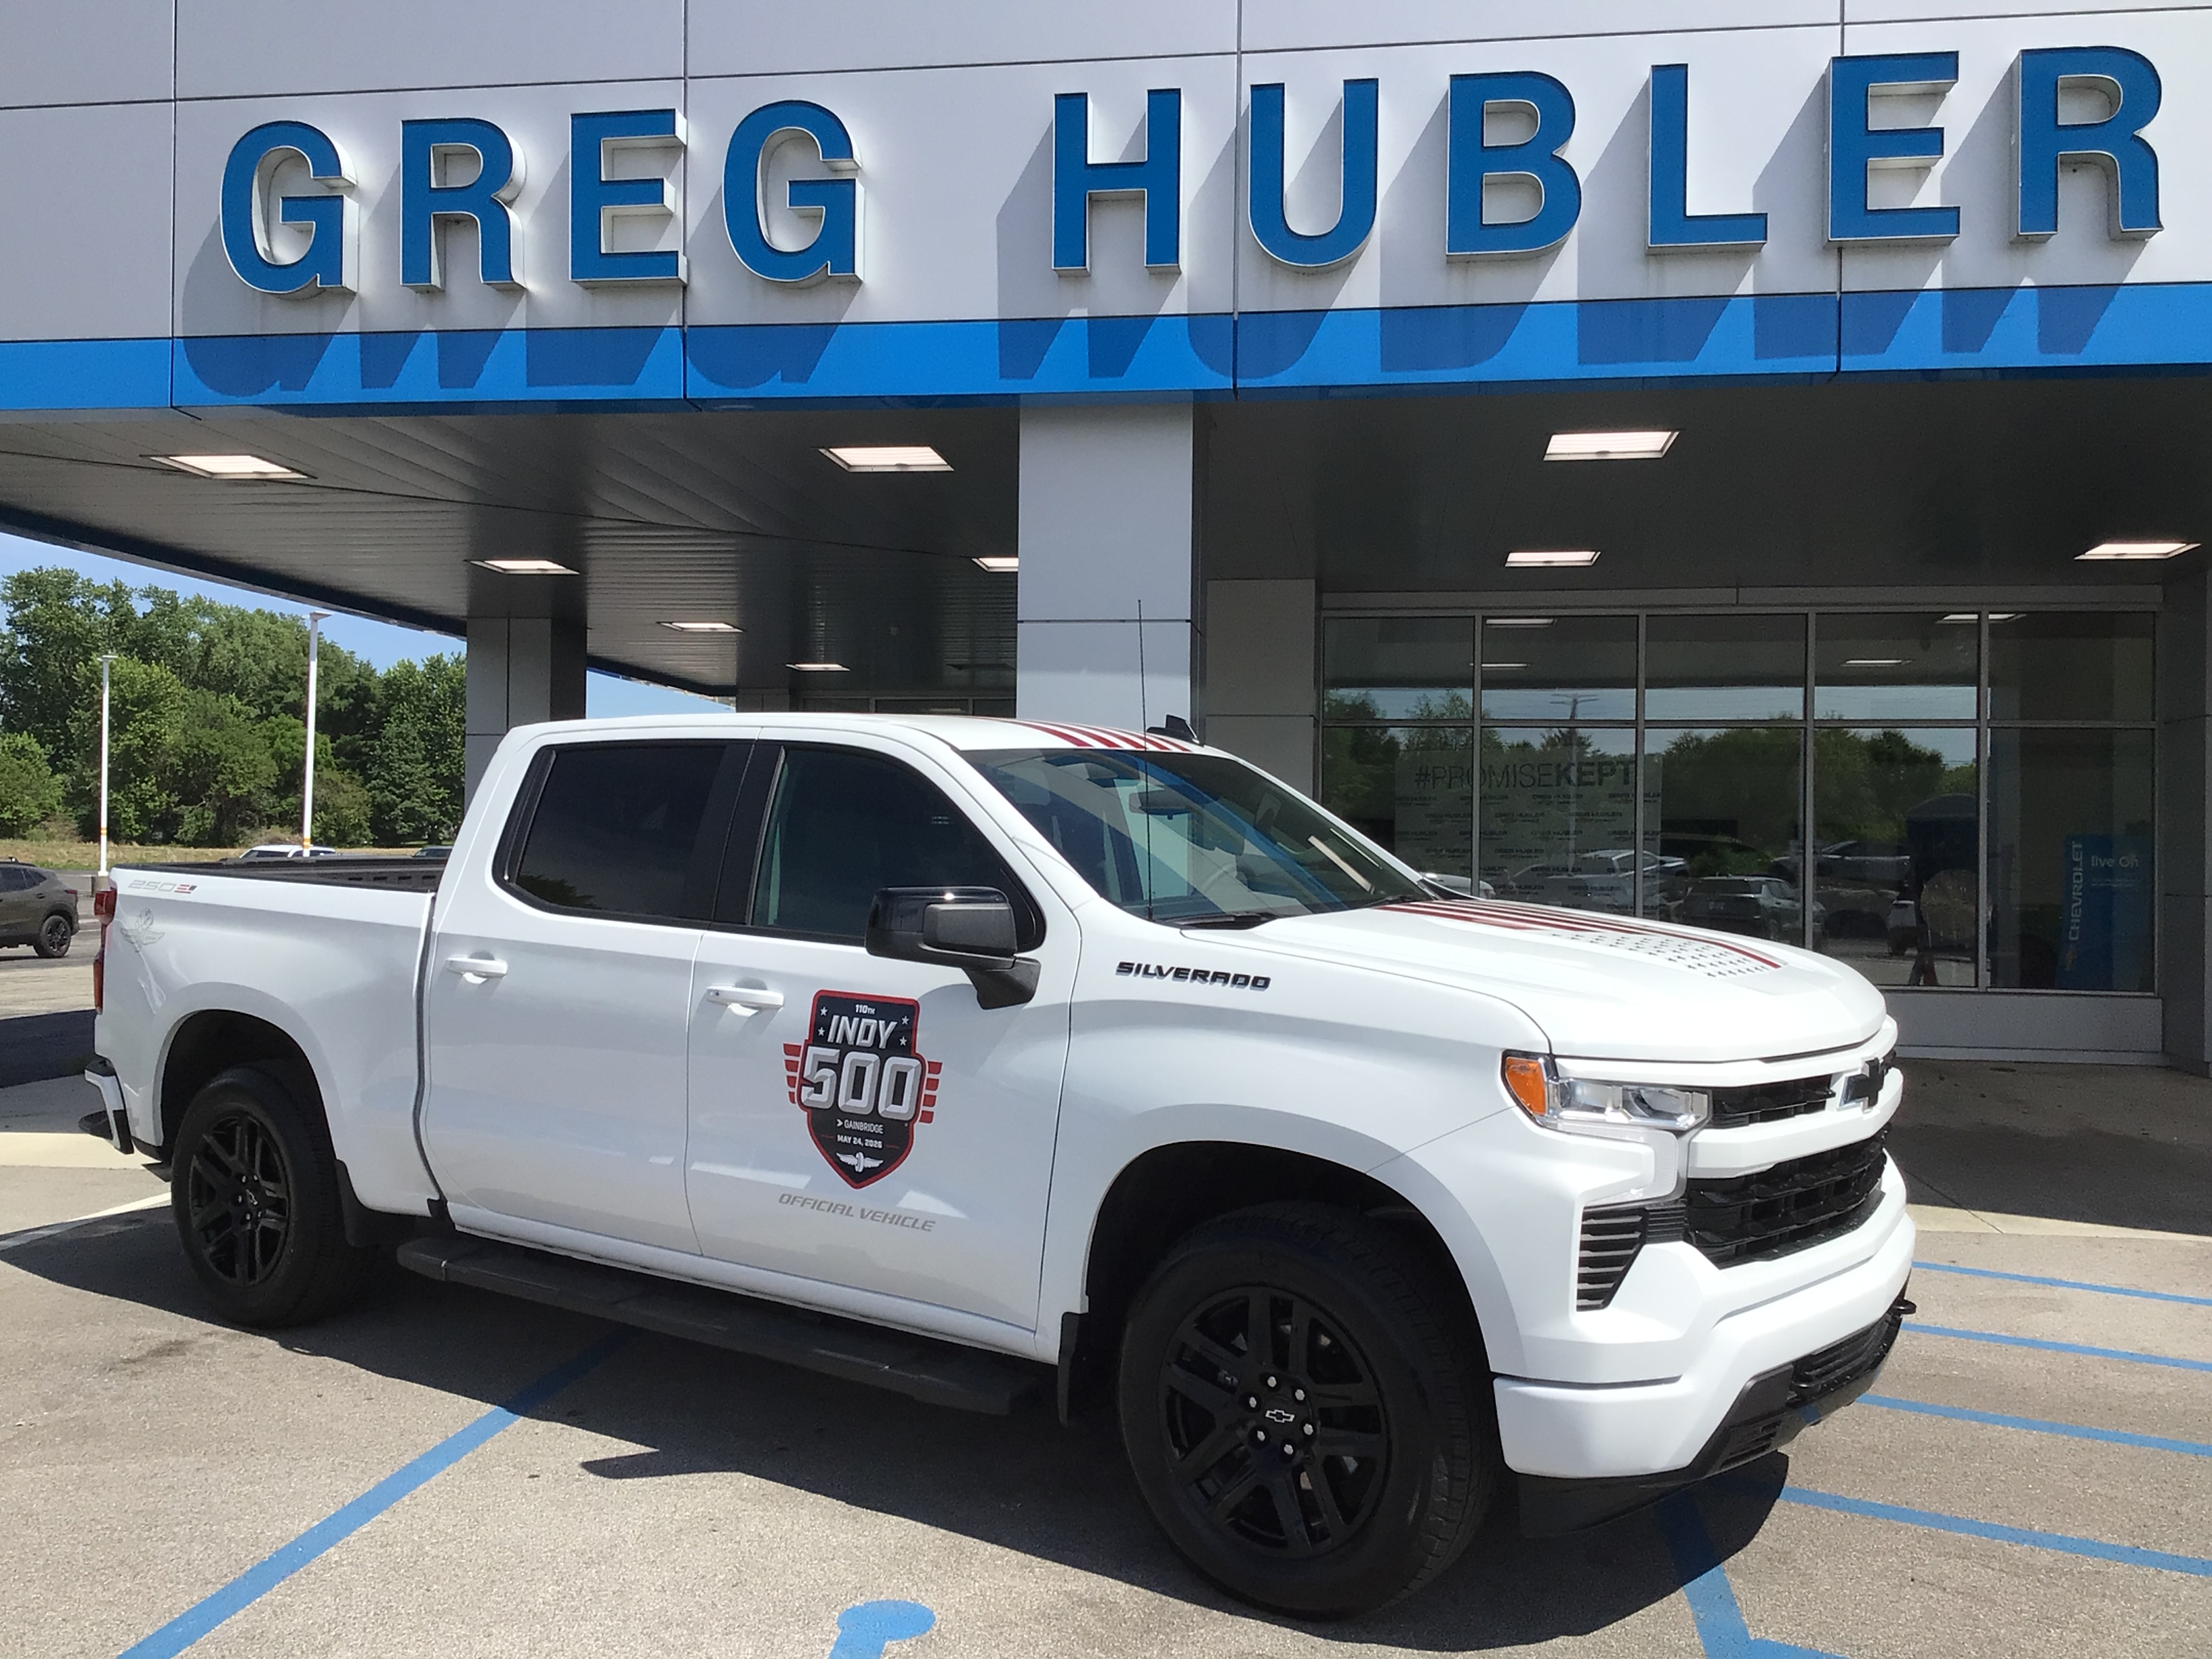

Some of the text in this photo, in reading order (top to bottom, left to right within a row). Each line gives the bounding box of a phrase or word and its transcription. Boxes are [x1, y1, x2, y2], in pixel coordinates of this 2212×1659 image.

[220, 47, 2164, 293] GREG HUBLER
[1415, 760, 1637, 790] #PROMISEKEPT
[2068, 840, 2083, 941] CHEVROLET
[1115, 961, 1271, 991] SILVERADO
[855, 1004, 876, 1015] 110TH
[827, 1015, 898, 1049] INDY
[800, 1046, 922, 1122] 500
[837, 1134, 882, 1149] MAY 24, 2026
[844, 1119, 884, 1134] GAINBRIDGE
[778, 1193, 936, 1232] OFFICIAL VEHICLE
